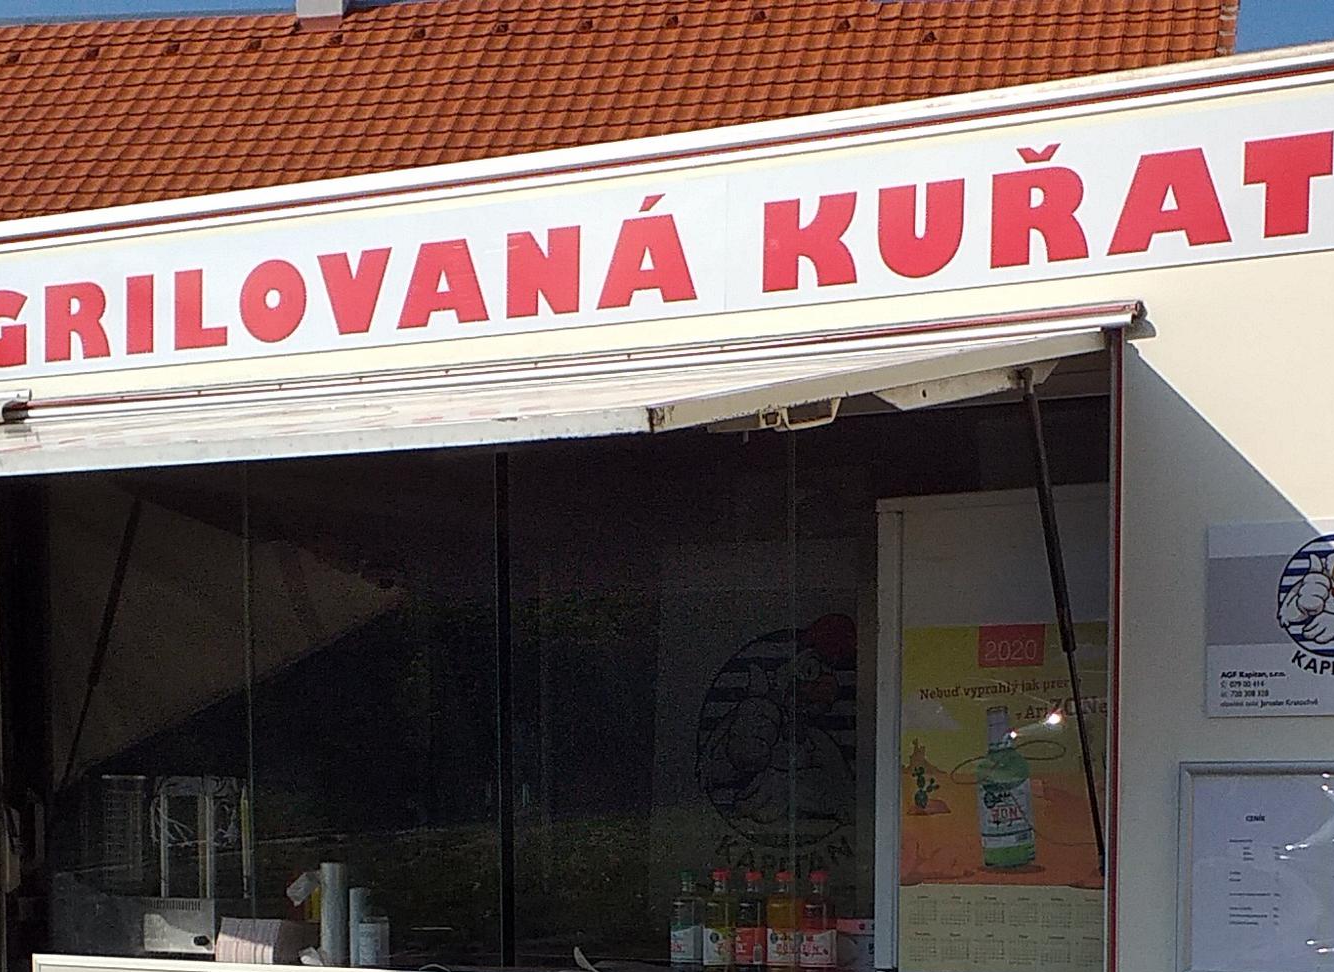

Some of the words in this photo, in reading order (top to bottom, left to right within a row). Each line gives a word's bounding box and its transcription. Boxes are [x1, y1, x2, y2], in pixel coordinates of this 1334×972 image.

[984, 639, 1037, 661] 2020
[919, 685, 960, 700] Nebuď
[963, 679, 1018, 698] vyprahlý
[1021, 679, 1040, 692] jak
